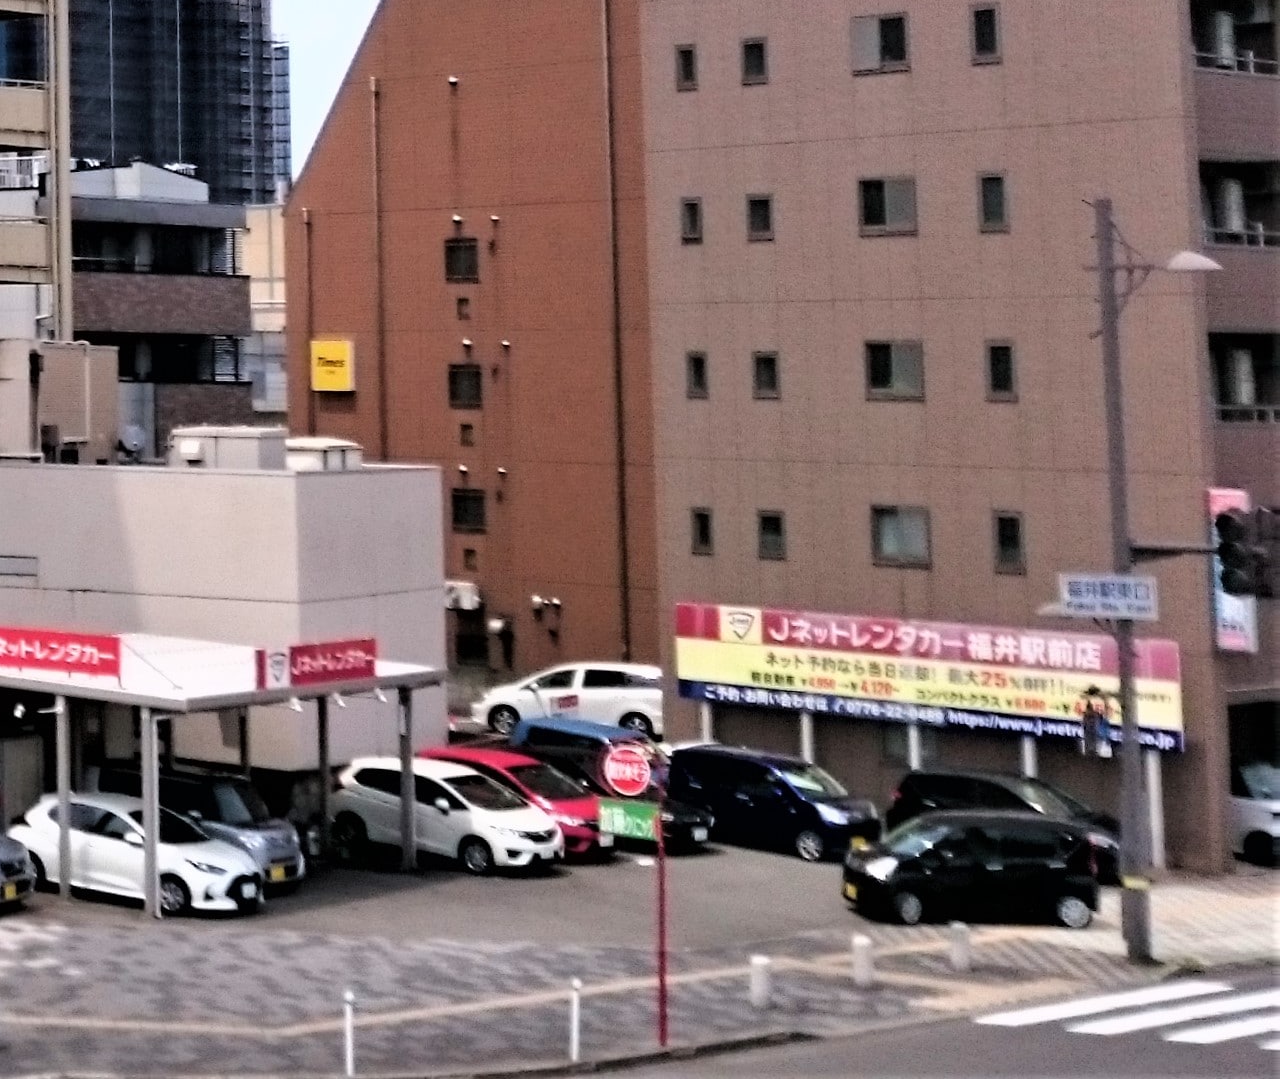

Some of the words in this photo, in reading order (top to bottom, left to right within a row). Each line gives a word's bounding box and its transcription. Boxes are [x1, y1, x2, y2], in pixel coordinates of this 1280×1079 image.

[317, 357, 345, 367] Times
[1068, 581, 1150, 600] 福井駅東口
[768, 617, 1101, 670] Jネットレンタカー福井駅前店
